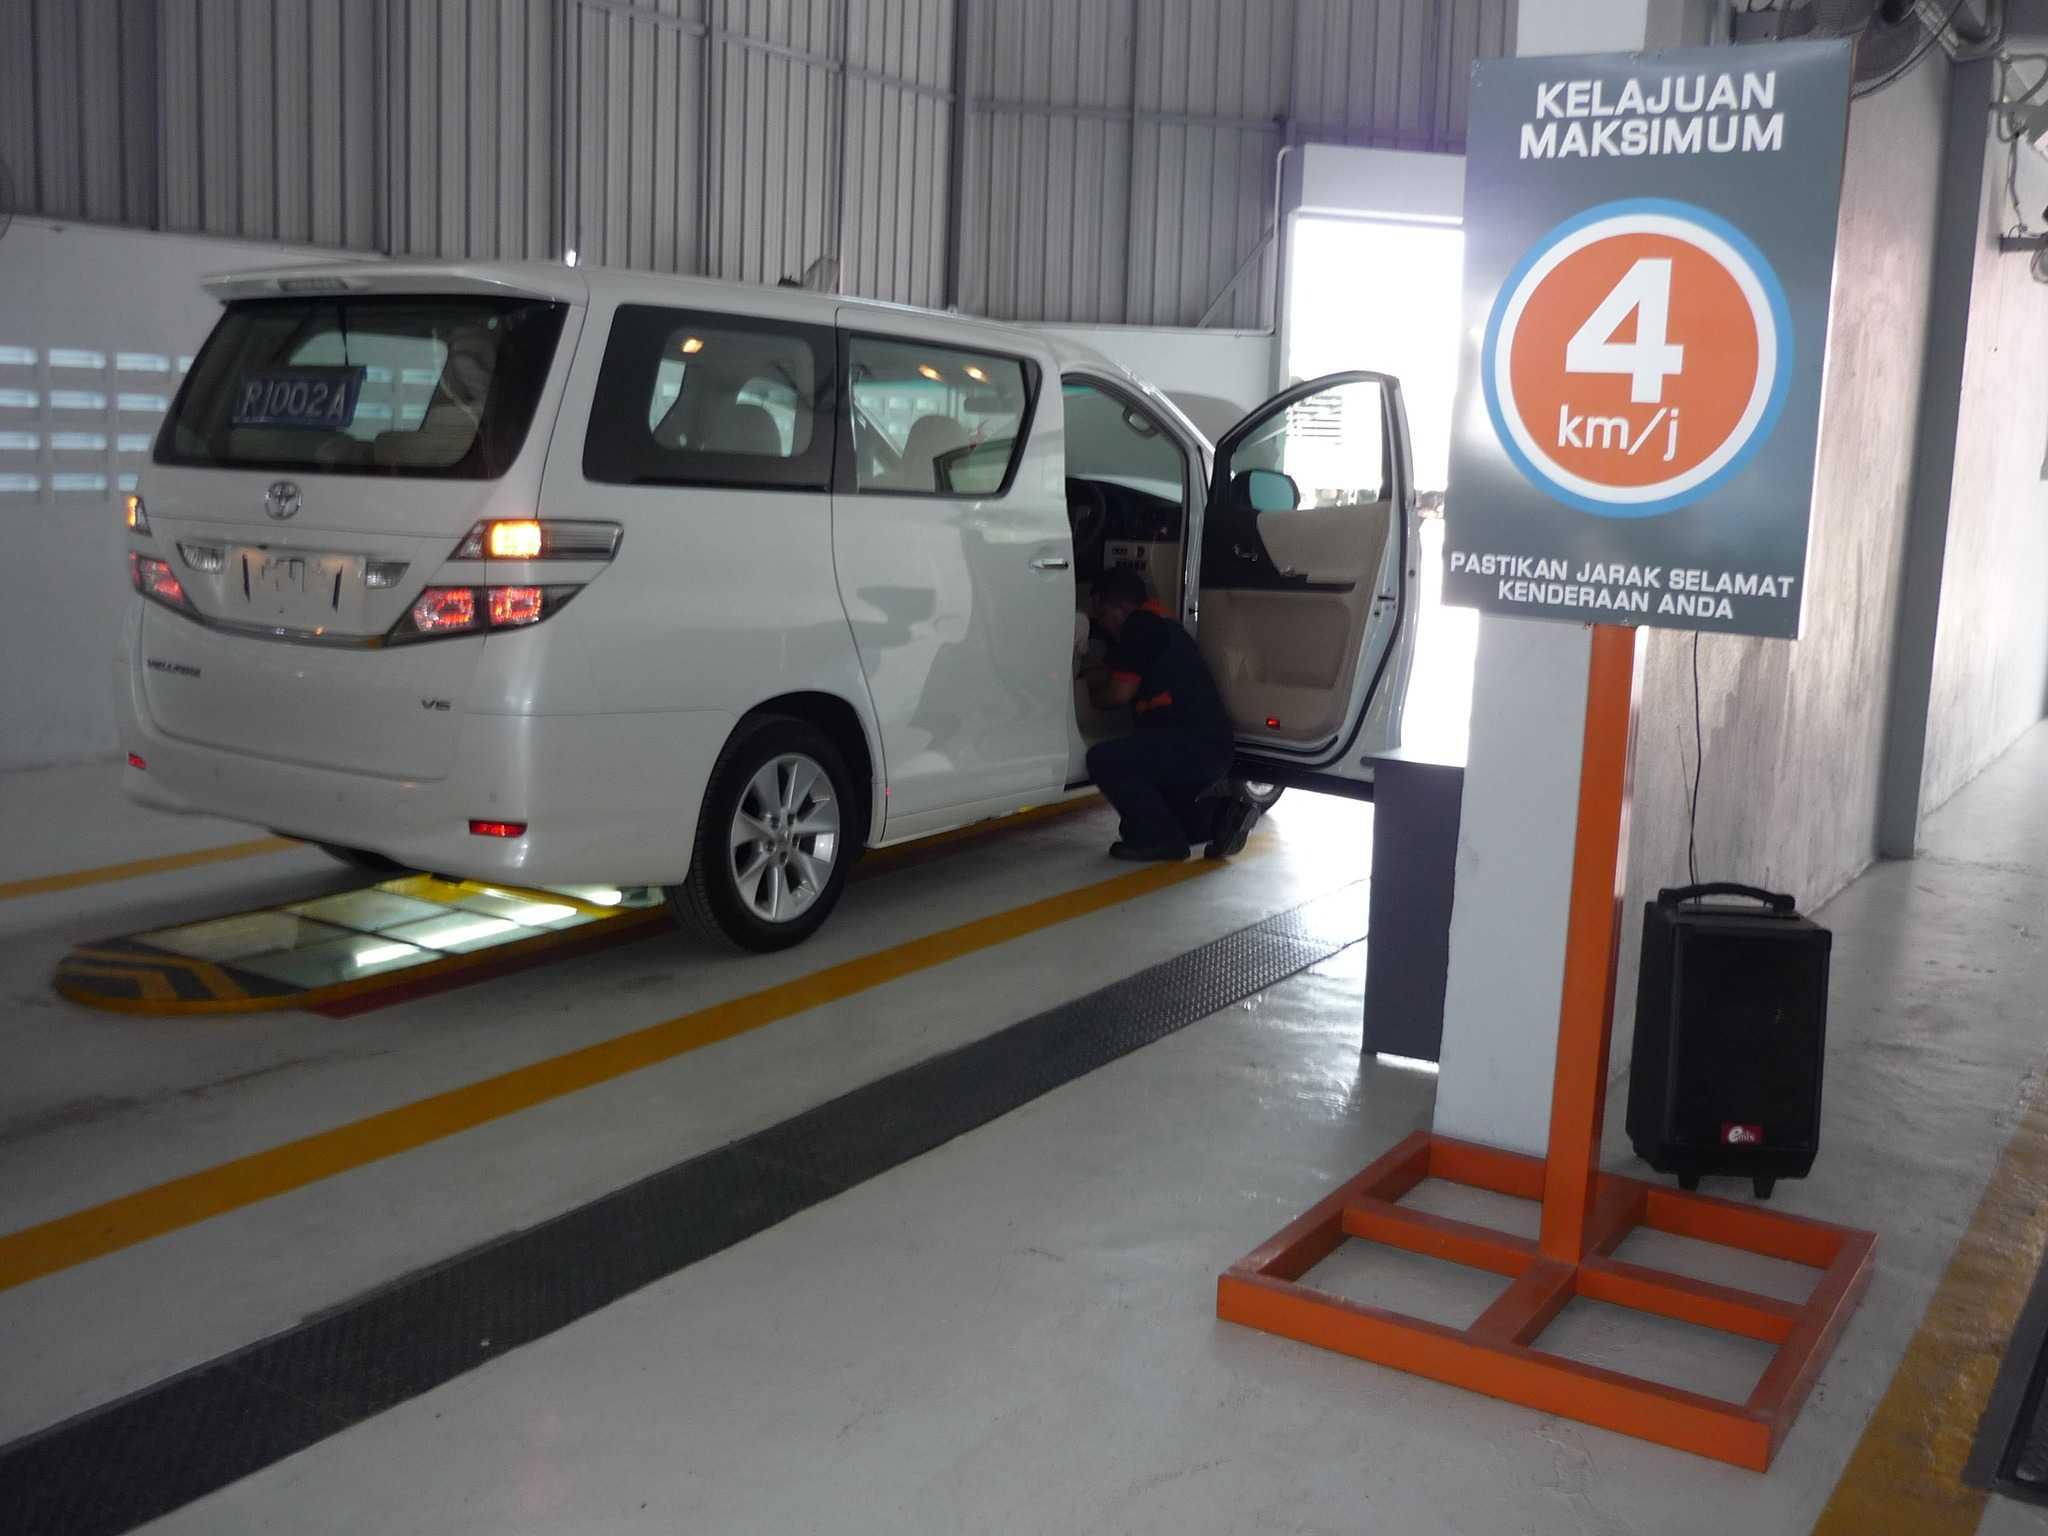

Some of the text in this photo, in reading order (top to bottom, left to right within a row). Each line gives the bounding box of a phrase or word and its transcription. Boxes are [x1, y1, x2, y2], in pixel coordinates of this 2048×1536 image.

[1536, 71, 1777, 119] KELAJUAN
[1519, 113, 1785, 159] MAKSIMUM
[1565, 257, 1684, 403] 4
[1557, 404, 1680, 462] km/j
[1450, 552, 1794, 598] PASTIKAN JARAK SELAMAT
[1498, 579, 1734, 619] KENDERAAN ANDA
